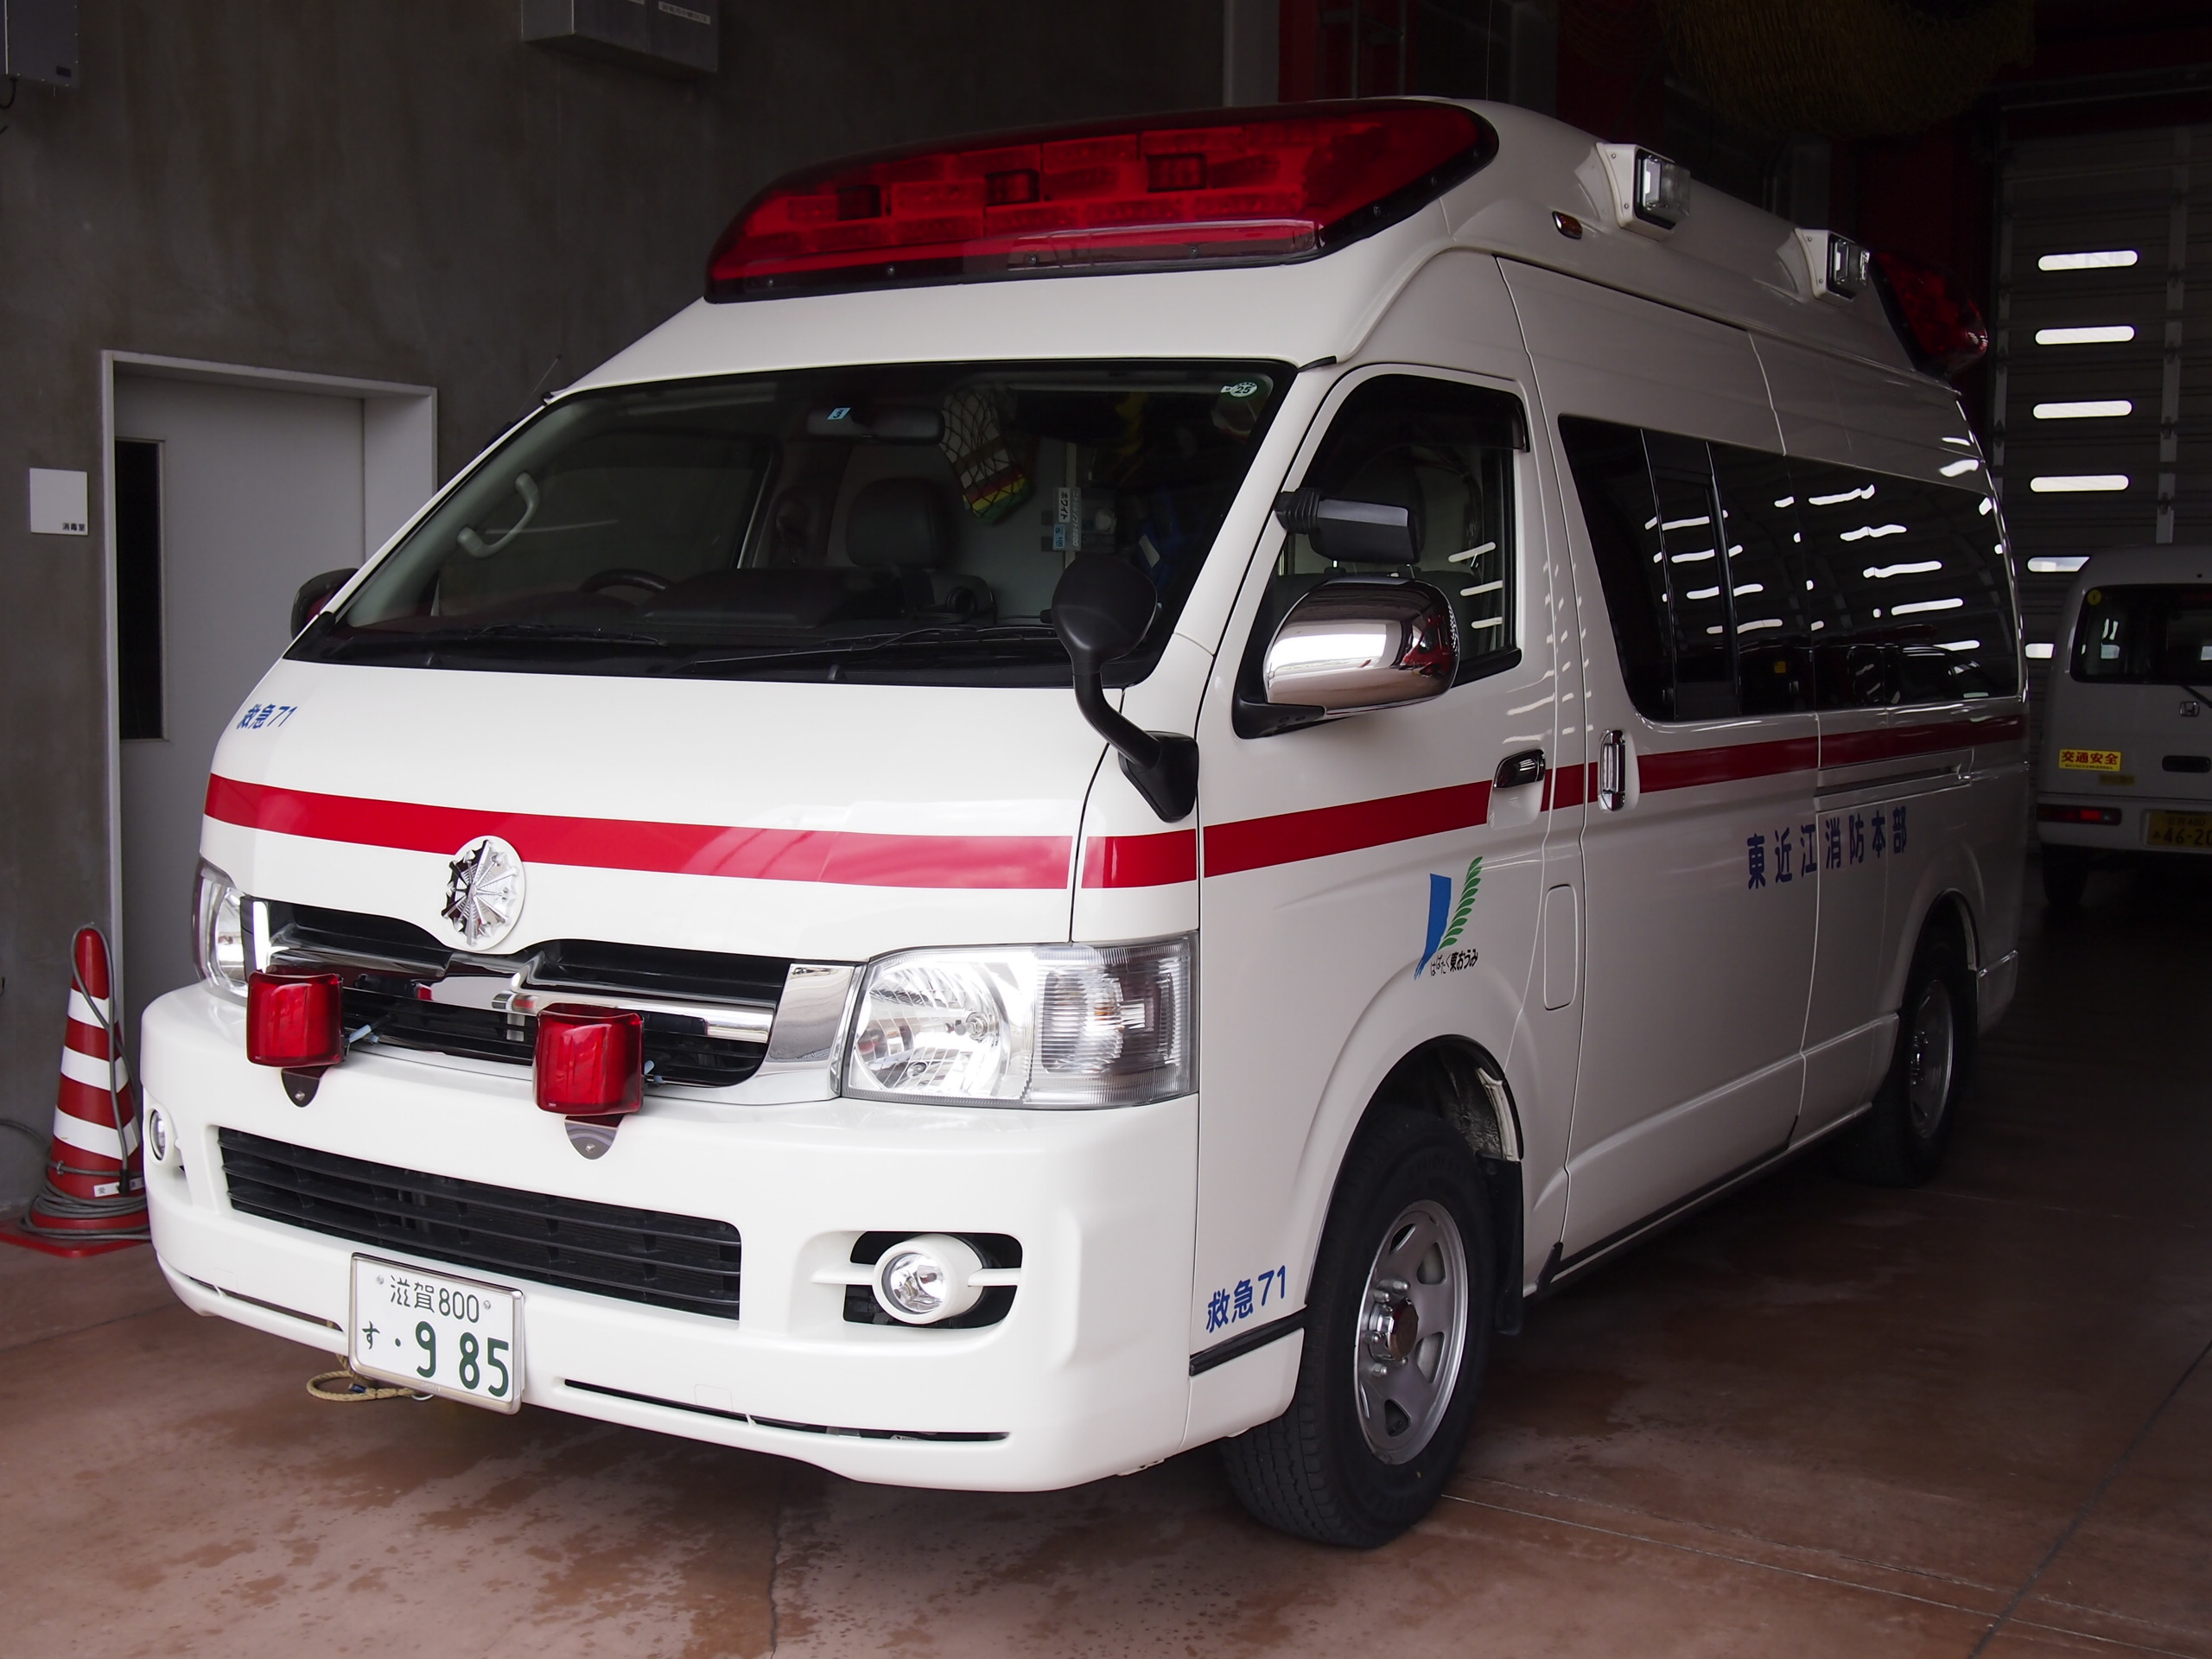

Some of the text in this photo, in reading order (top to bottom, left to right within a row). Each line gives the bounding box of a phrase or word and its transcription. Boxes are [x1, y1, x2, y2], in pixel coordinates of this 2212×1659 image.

[1234, 385, 1252, 394] 25
[1060, 492, 1069, 520] ホワイト
[236, 702, 298, 730] 救急71
[2061, 750, 2119, 766] 交通安全
[1746, 805, 1908, 890] 東近江消防本部
[390, 1274, 480, 1324] 滋賀800
[1205, 1264, 1286, 1334] 救急71
